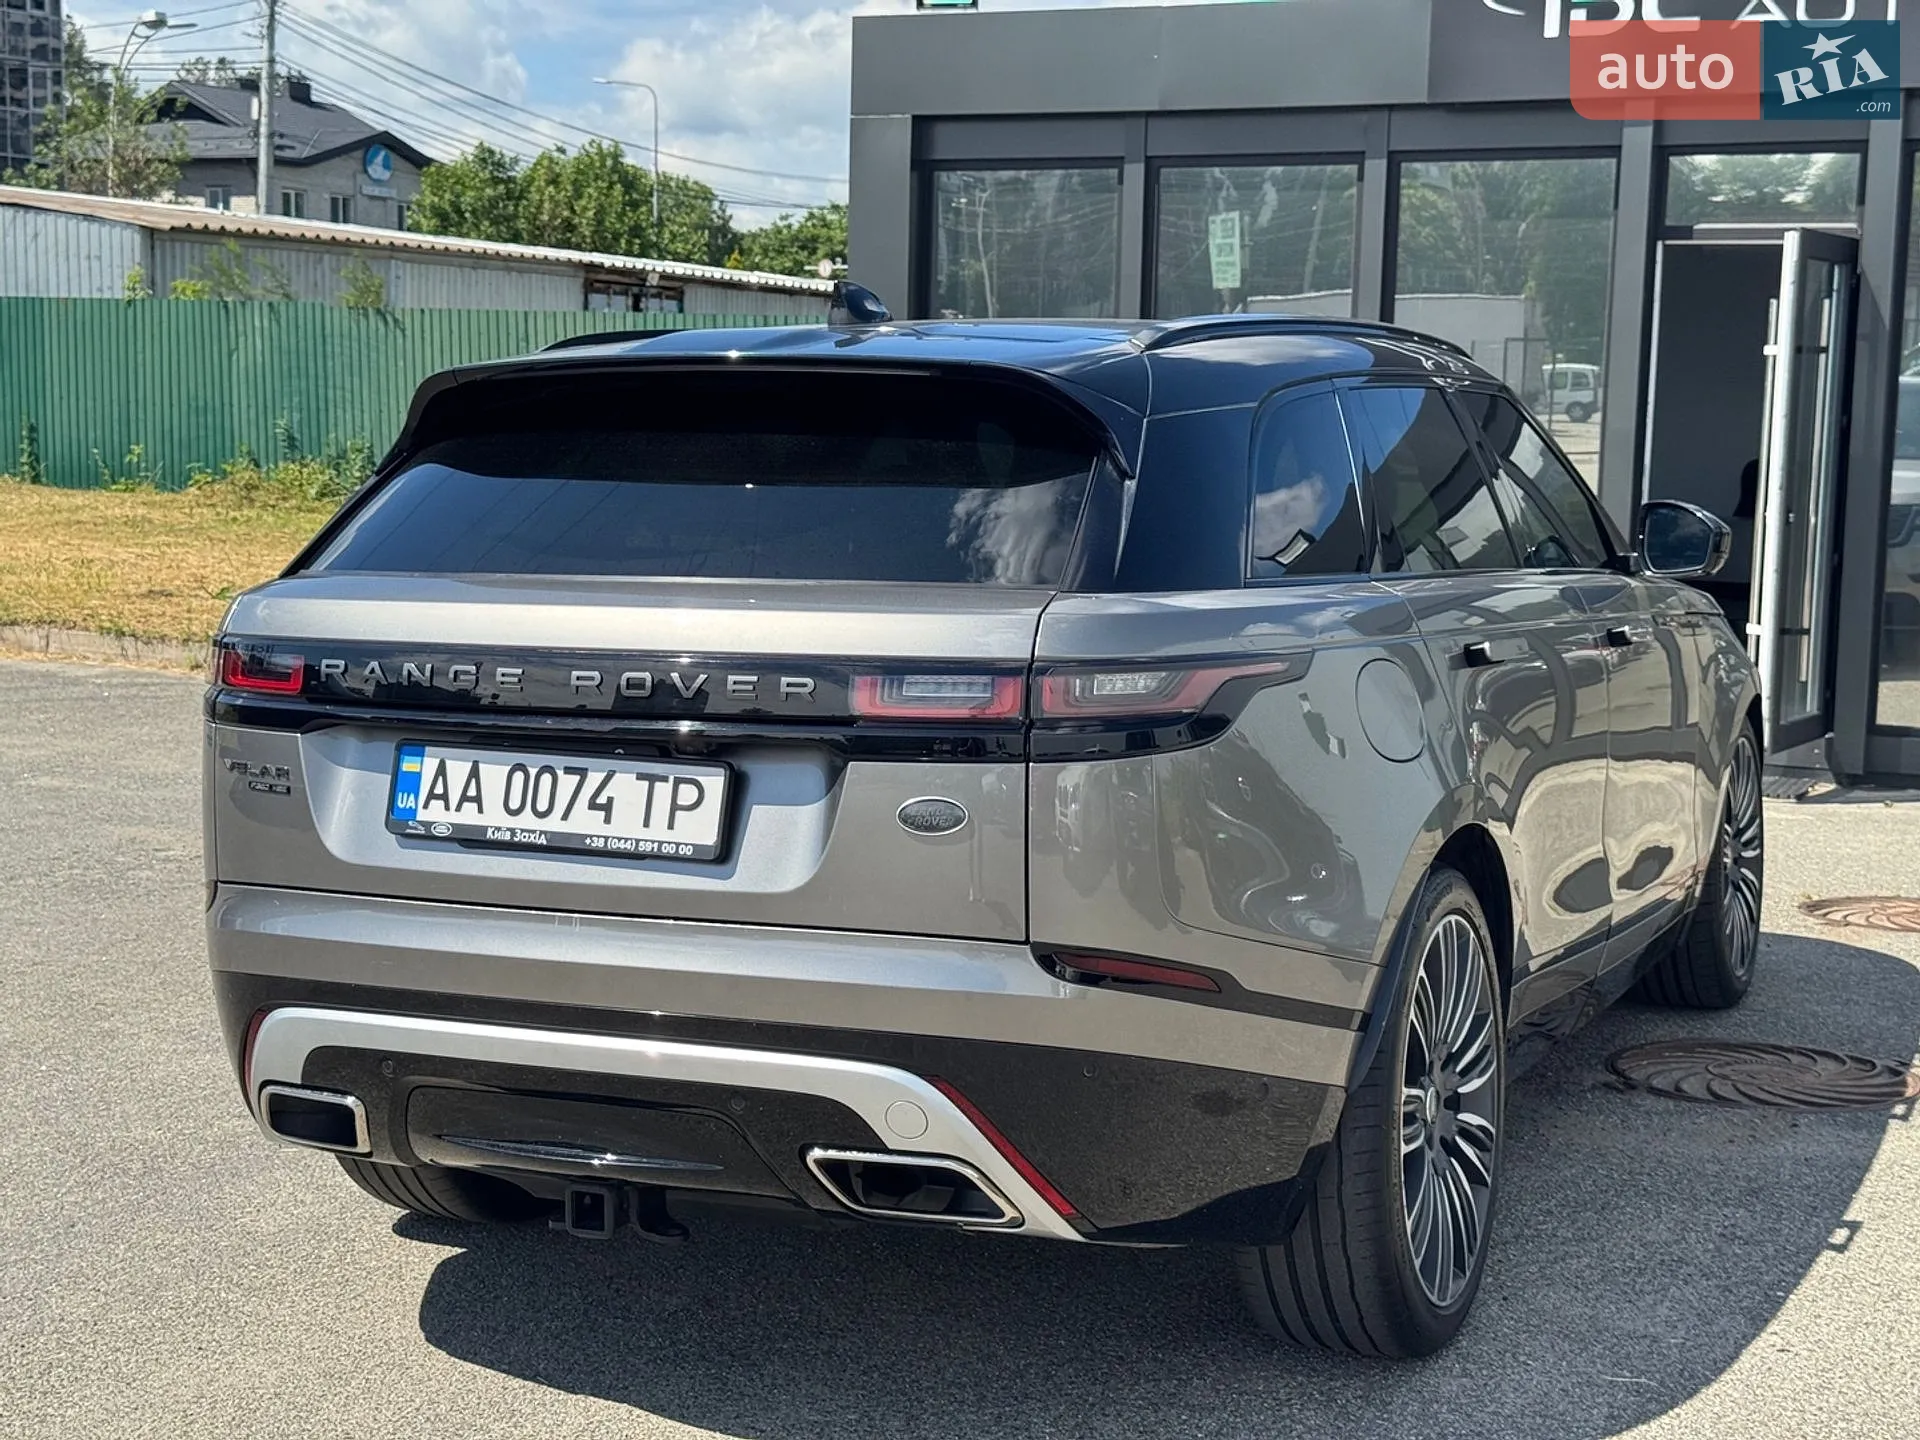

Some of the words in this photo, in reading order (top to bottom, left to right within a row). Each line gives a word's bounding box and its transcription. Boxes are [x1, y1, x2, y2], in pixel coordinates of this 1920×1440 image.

[320, 659, 525, 692] RANGE
[570, 670, 816, 702] ROVER
[397, 791, 416, 810] UA
[422, 758, 484, 815] AA
[502, 763, 616, 825] 0074
[635, 772, 706, 831] TP
[486, 826, 511, 840] Київ
[584, 836, 605, 848] +38
[607, 837, 636, 851] (044)
[638, 841, 659, 853] 591
[661, 842, 676, 854] 00
[678, 845, 693, 856] 00
